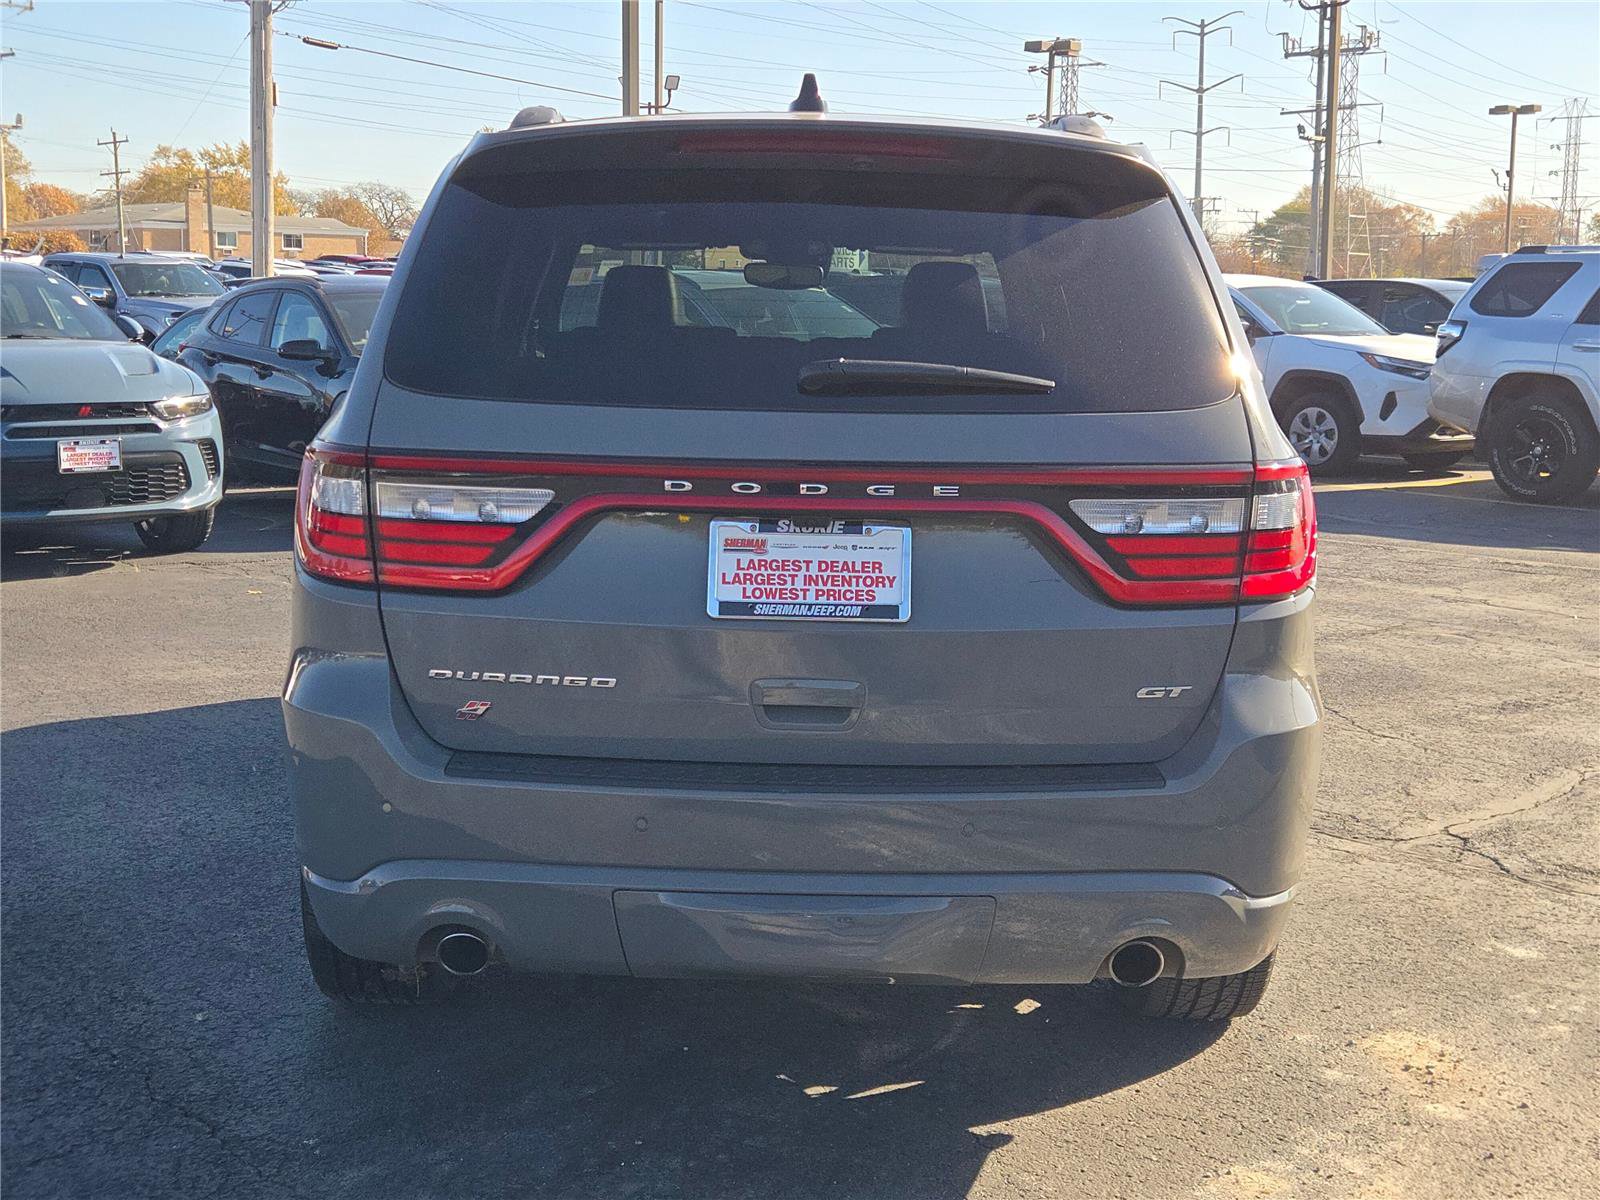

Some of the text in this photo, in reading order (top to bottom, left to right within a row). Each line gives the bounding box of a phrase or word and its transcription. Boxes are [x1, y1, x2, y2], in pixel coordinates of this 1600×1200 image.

[664, 480, 960, 497] DODGE
[723, 537, 767, 549] SHERMAN
[736, 558, 883, 574] LARGEST DEALER
[721, 573, 897, 588] LARGEST INVENTORY
[742, 587, 877, 602] LOWEST PRICES
[753, 604, 863, 617] SHERMANJEEP.COM
[428, 669, 617, 688] DURANGO
[1136, 685, 1193, 698] GT
